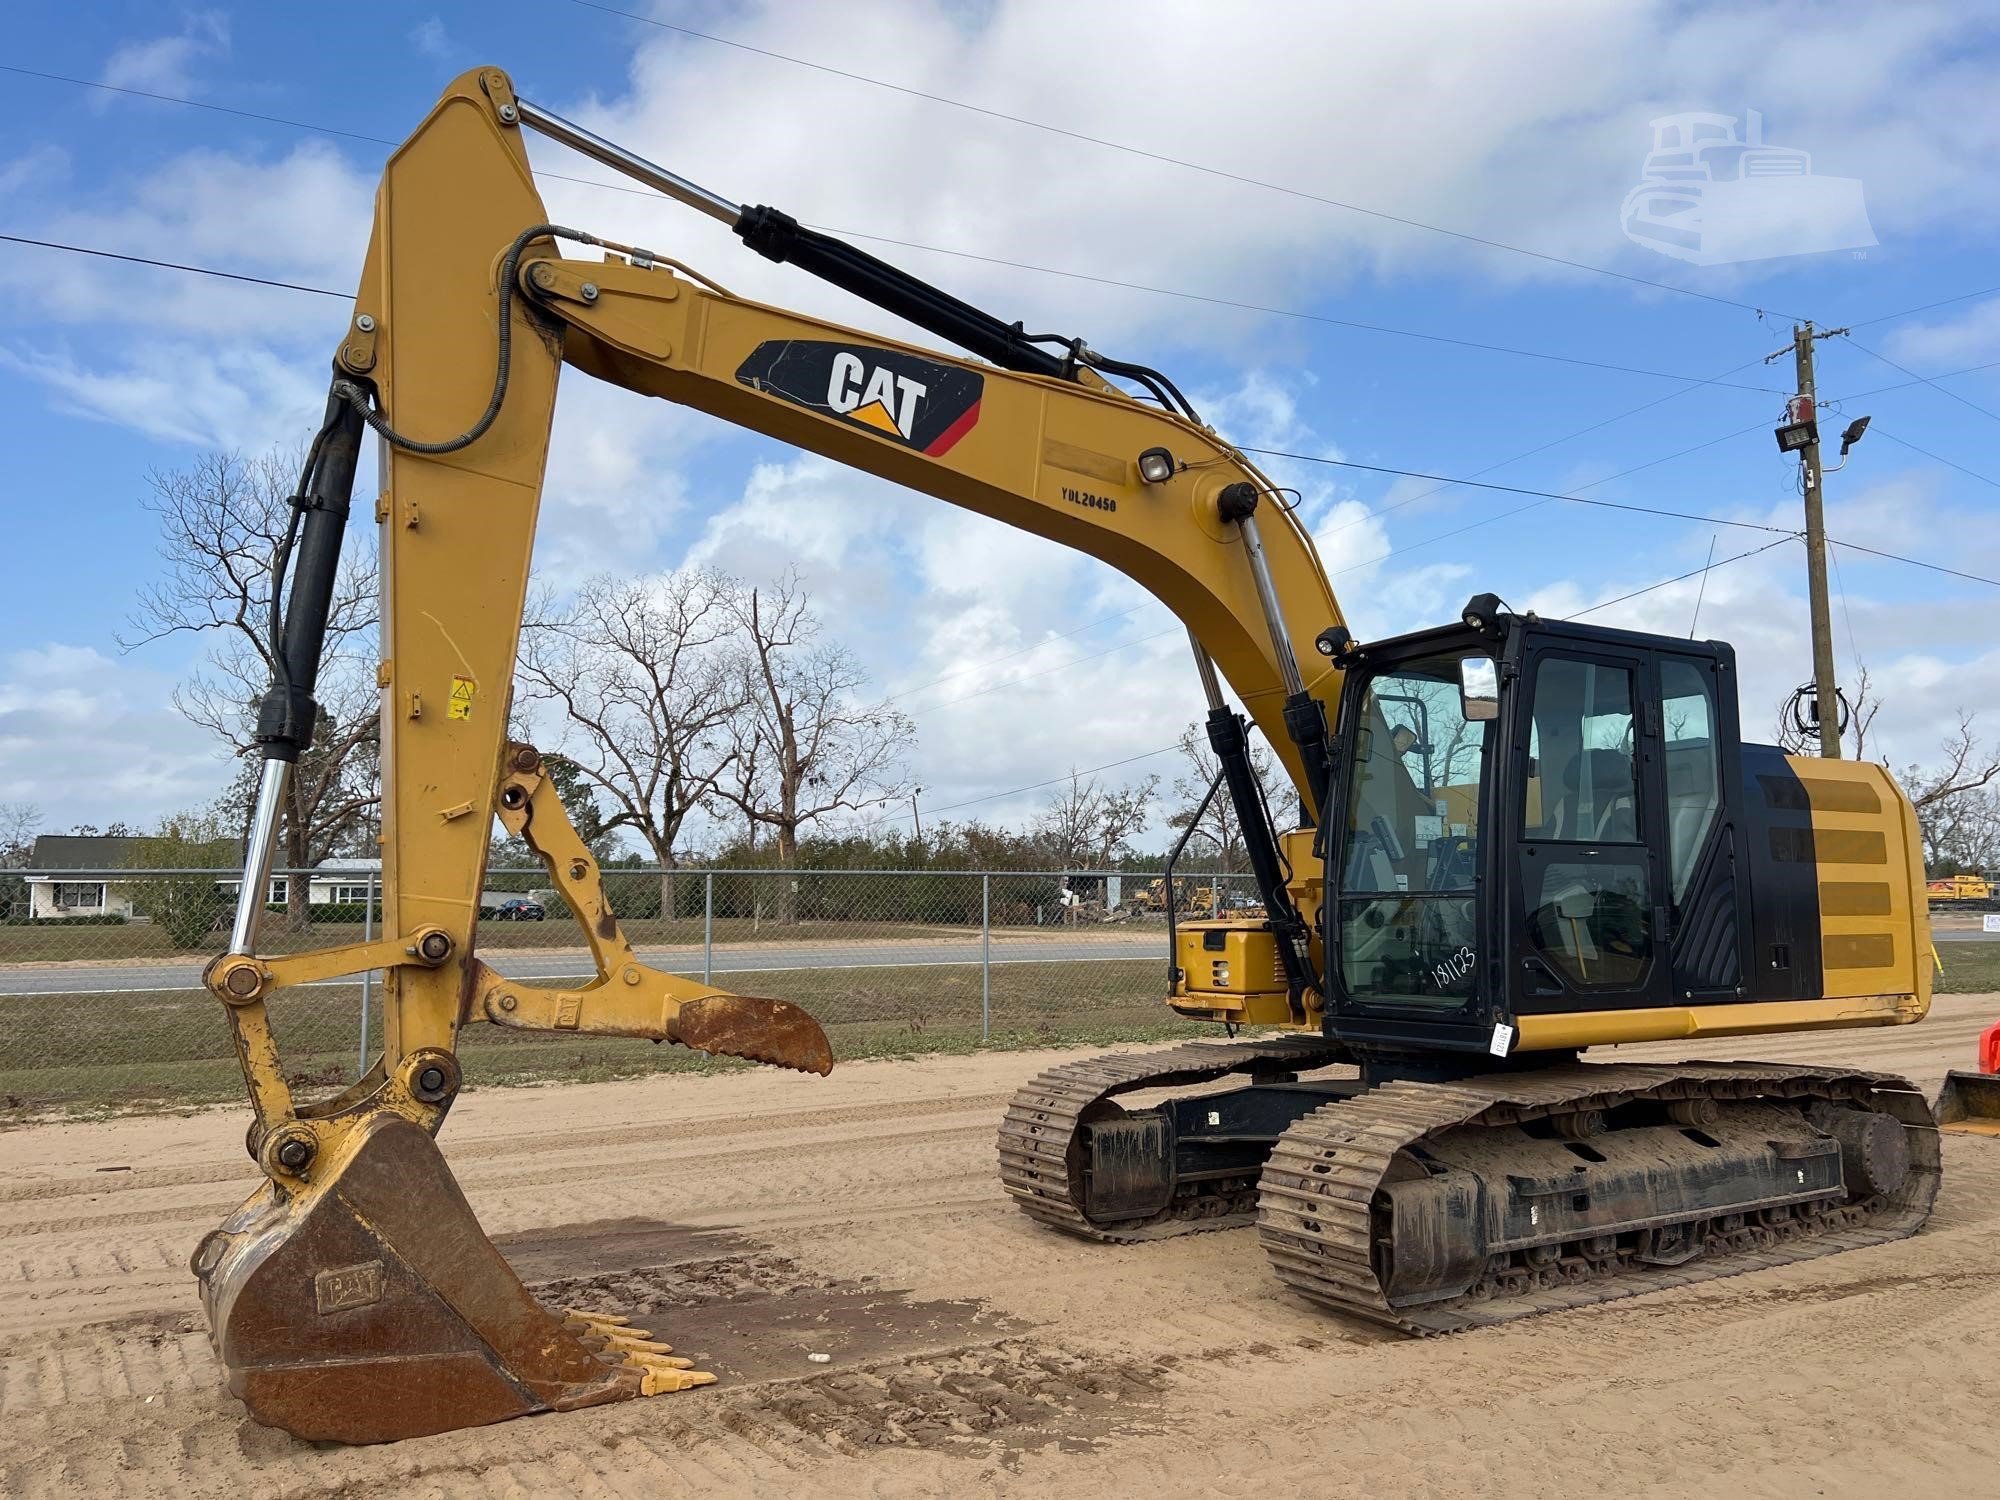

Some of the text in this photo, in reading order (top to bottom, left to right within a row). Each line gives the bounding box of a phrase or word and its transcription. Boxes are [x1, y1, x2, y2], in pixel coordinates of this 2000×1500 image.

[827, 352, 927, 440] CAT
[1061, 486, 1117, 513] YDL20450
[1431, 946, 1475, 989] 181123
